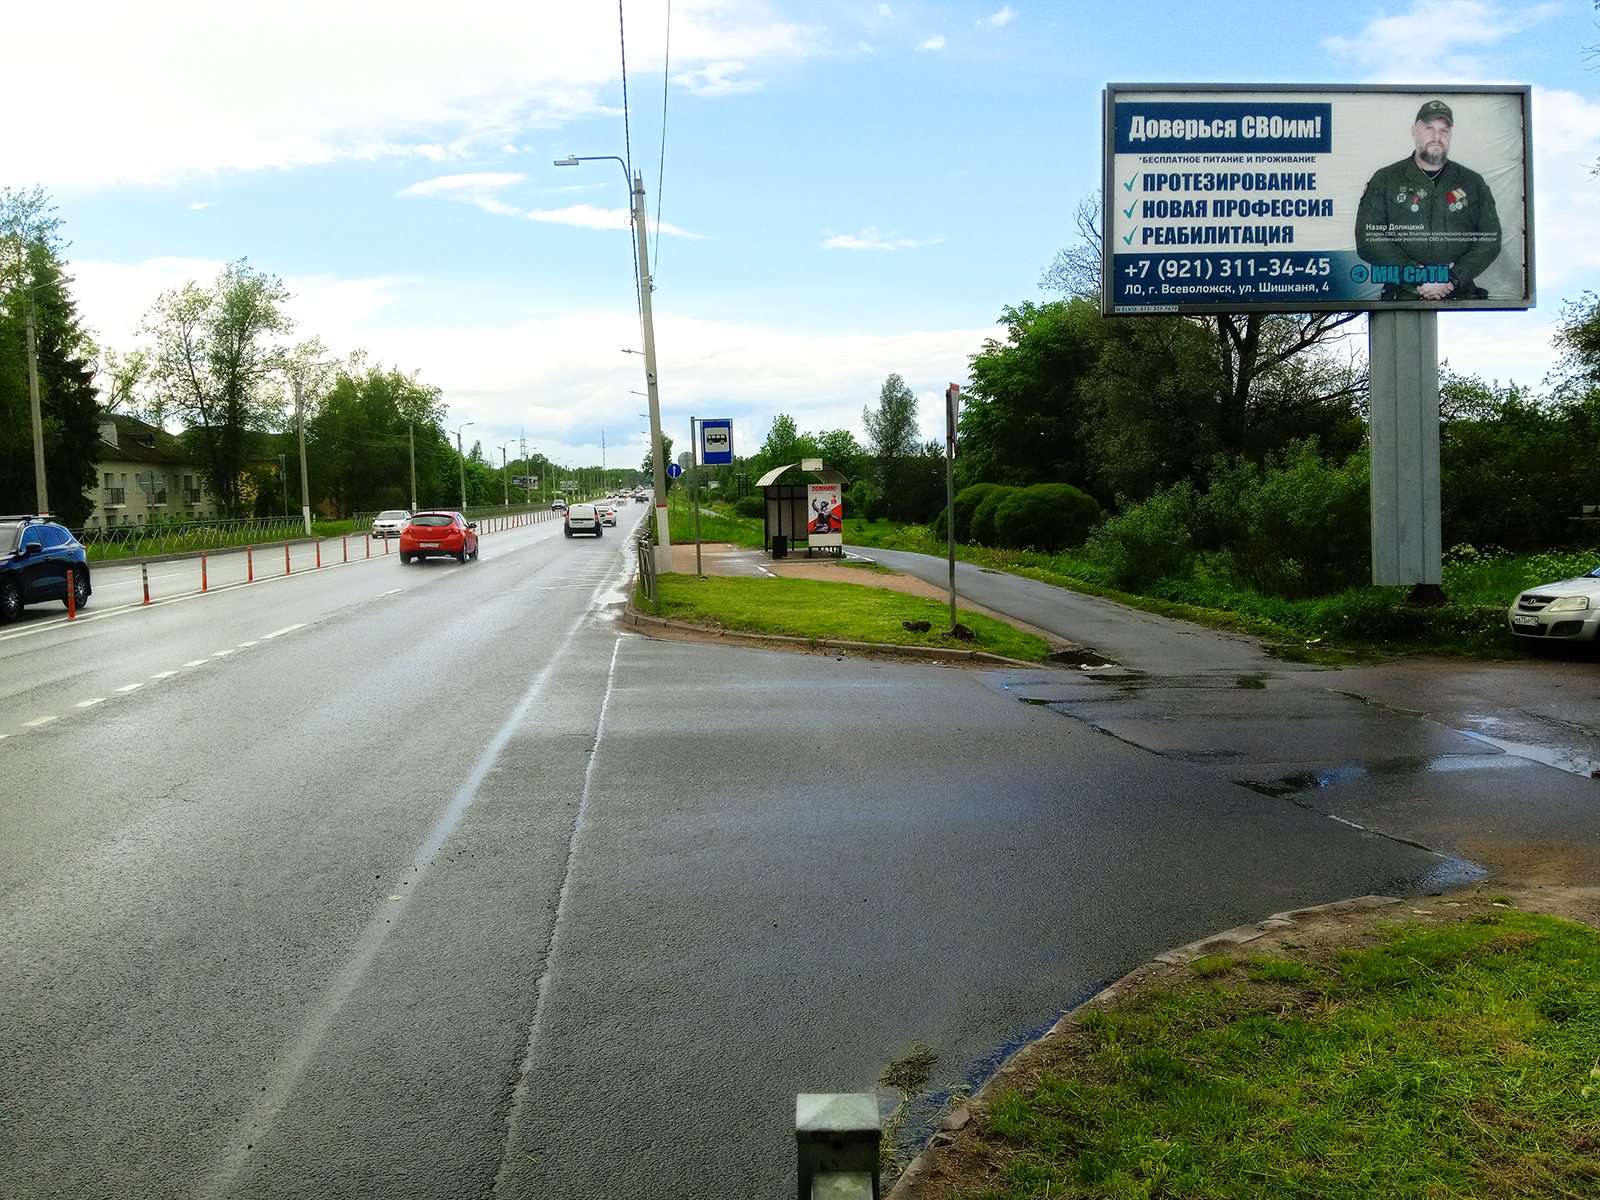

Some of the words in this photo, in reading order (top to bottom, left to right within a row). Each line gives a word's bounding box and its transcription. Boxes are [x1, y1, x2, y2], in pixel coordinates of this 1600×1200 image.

[1129, 115, 1237, 142] Доверься
[1241, 115, 1322, 138] СВОим!
[1143, 172, 1317, 192] ПРОТЕЗИРОВАНИЕ
[1142, 199, 1208, 218] НОВАЯ
[1213, 198, 1334, 218] ПРОФЕССИЯ
[1142, 226, 1294, 246] РЕАБИЛИТАЦИЯ
[1365, 223, 1388, 232] Назар
[1125, 260, 1151, 278] +7
[1158, 258, 1213, 280] (921)
[1219, 258, 1330, 277] 311-34-45
[1371, 265, 1400, 285] МЦ
[1124, 284, 1146, 296] ЛО,
[1149, 286, 1158, 294] г.
[1161, 284, 1236, 295] Всеволожск,
[1239, 285, 1256, 295] ул.
[1259, 282, 1319, 293] Шишканя,
[1322, 281, 1329, 291] 4
